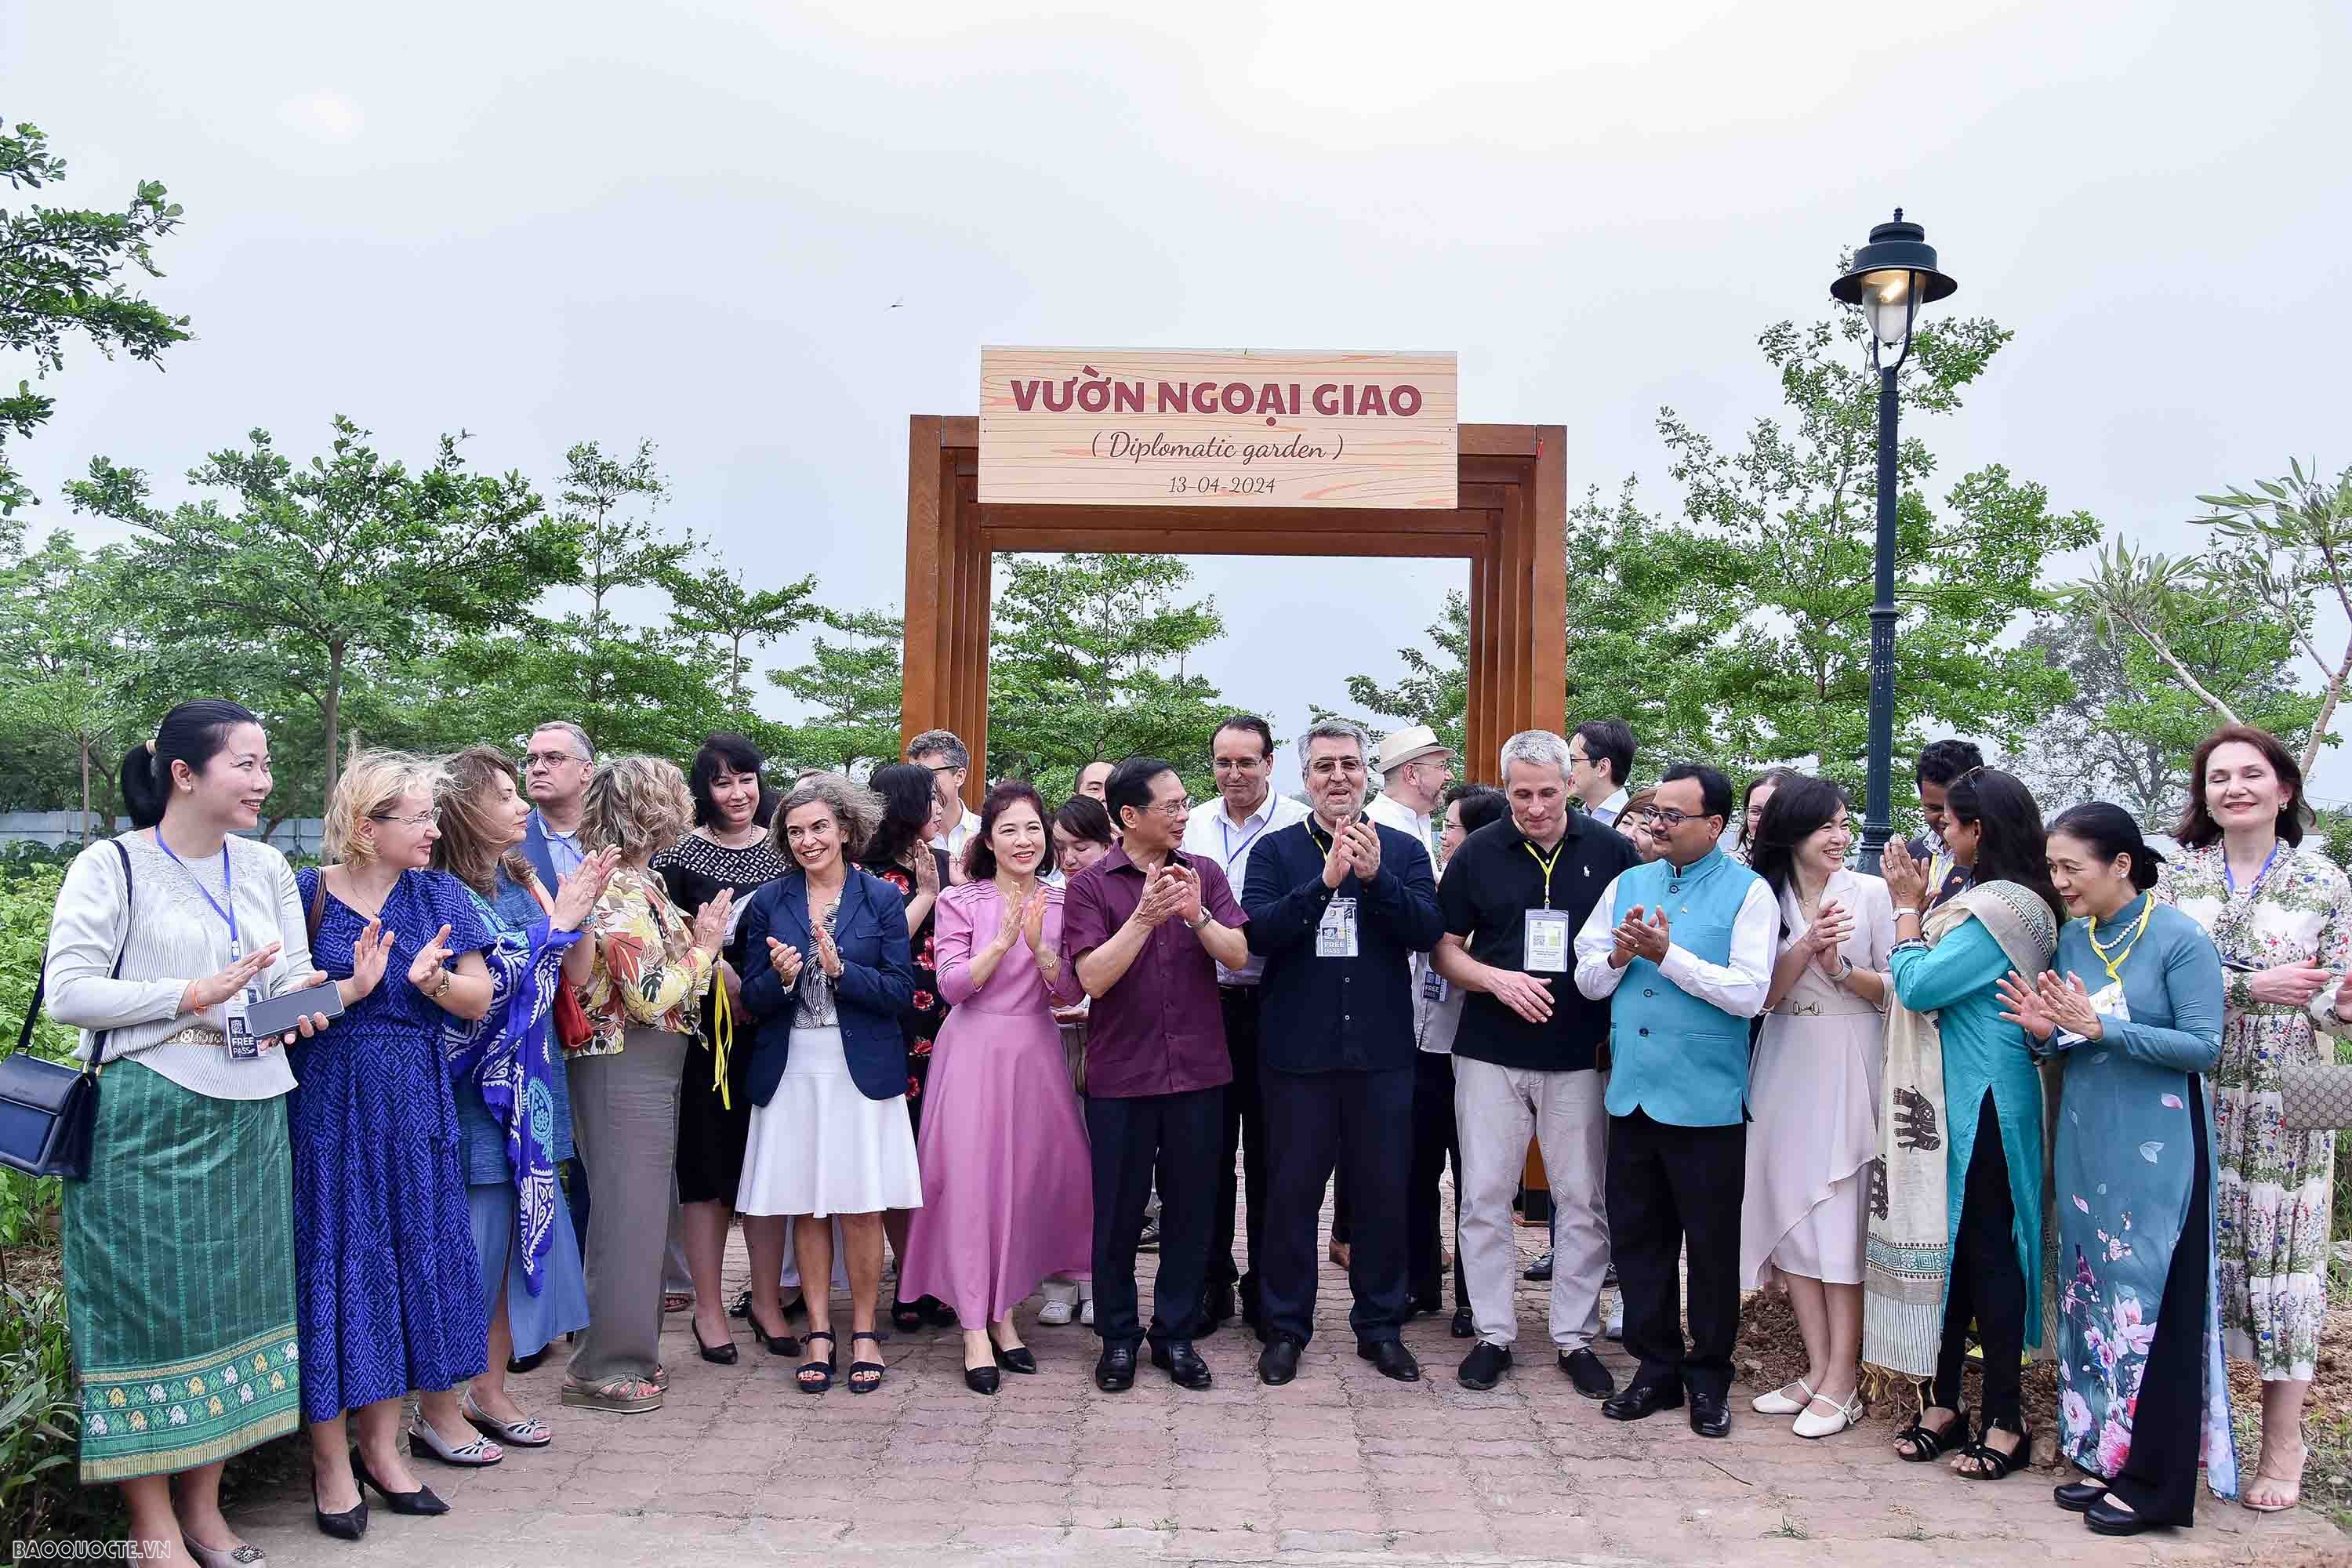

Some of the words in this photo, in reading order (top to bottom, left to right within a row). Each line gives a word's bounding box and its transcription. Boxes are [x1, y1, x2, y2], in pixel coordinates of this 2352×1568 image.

[1010, 365, 1145, 413] VƯỜN
[1157, 382, 1301, 426] NGOẠI
[1312, 383, 1422, 417] GIAO
[1168, 476, 1276, 494] 13-04-2024
[232, 1036, 255, 1047] FREE
